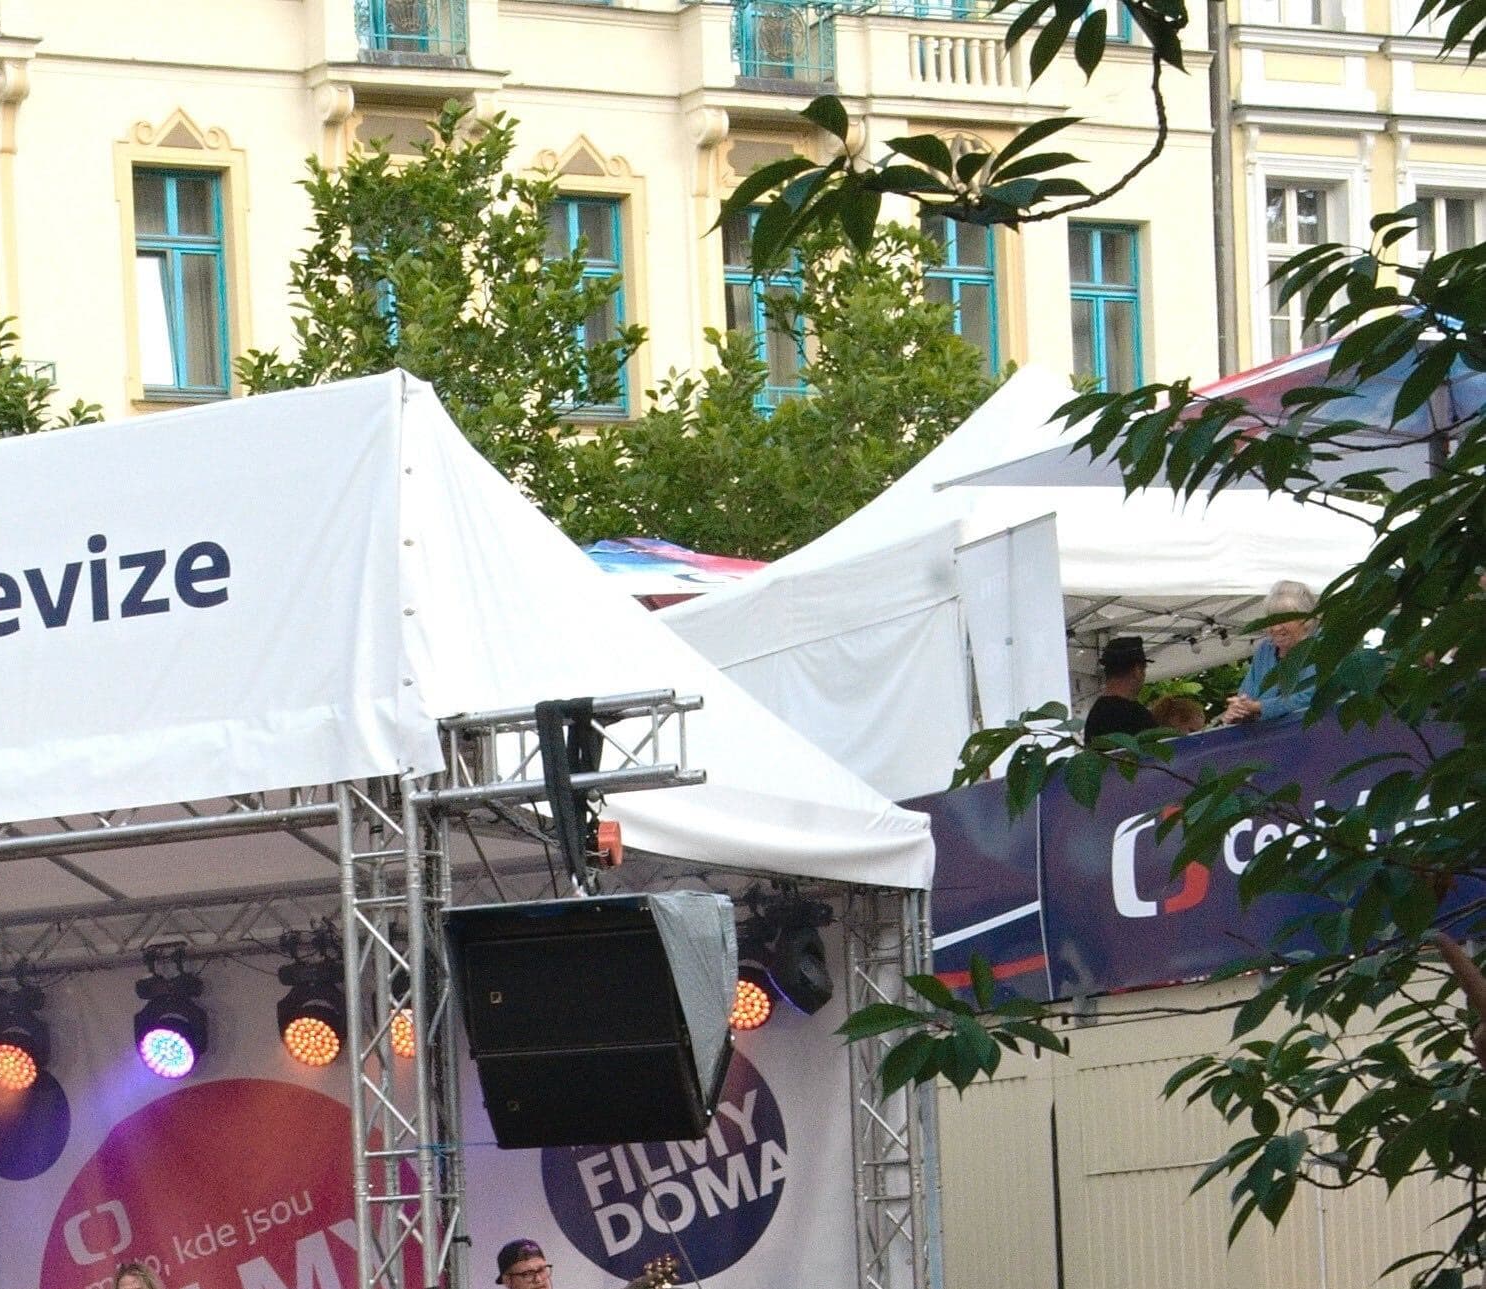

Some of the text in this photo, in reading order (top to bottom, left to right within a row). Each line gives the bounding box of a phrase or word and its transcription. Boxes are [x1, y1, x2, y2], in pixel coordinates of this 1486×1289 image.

[172, 1224, 238, 1264] kde
[242, 1191, 314, 1245] jsou
[593, 1139, 787, 1257] DOMA
